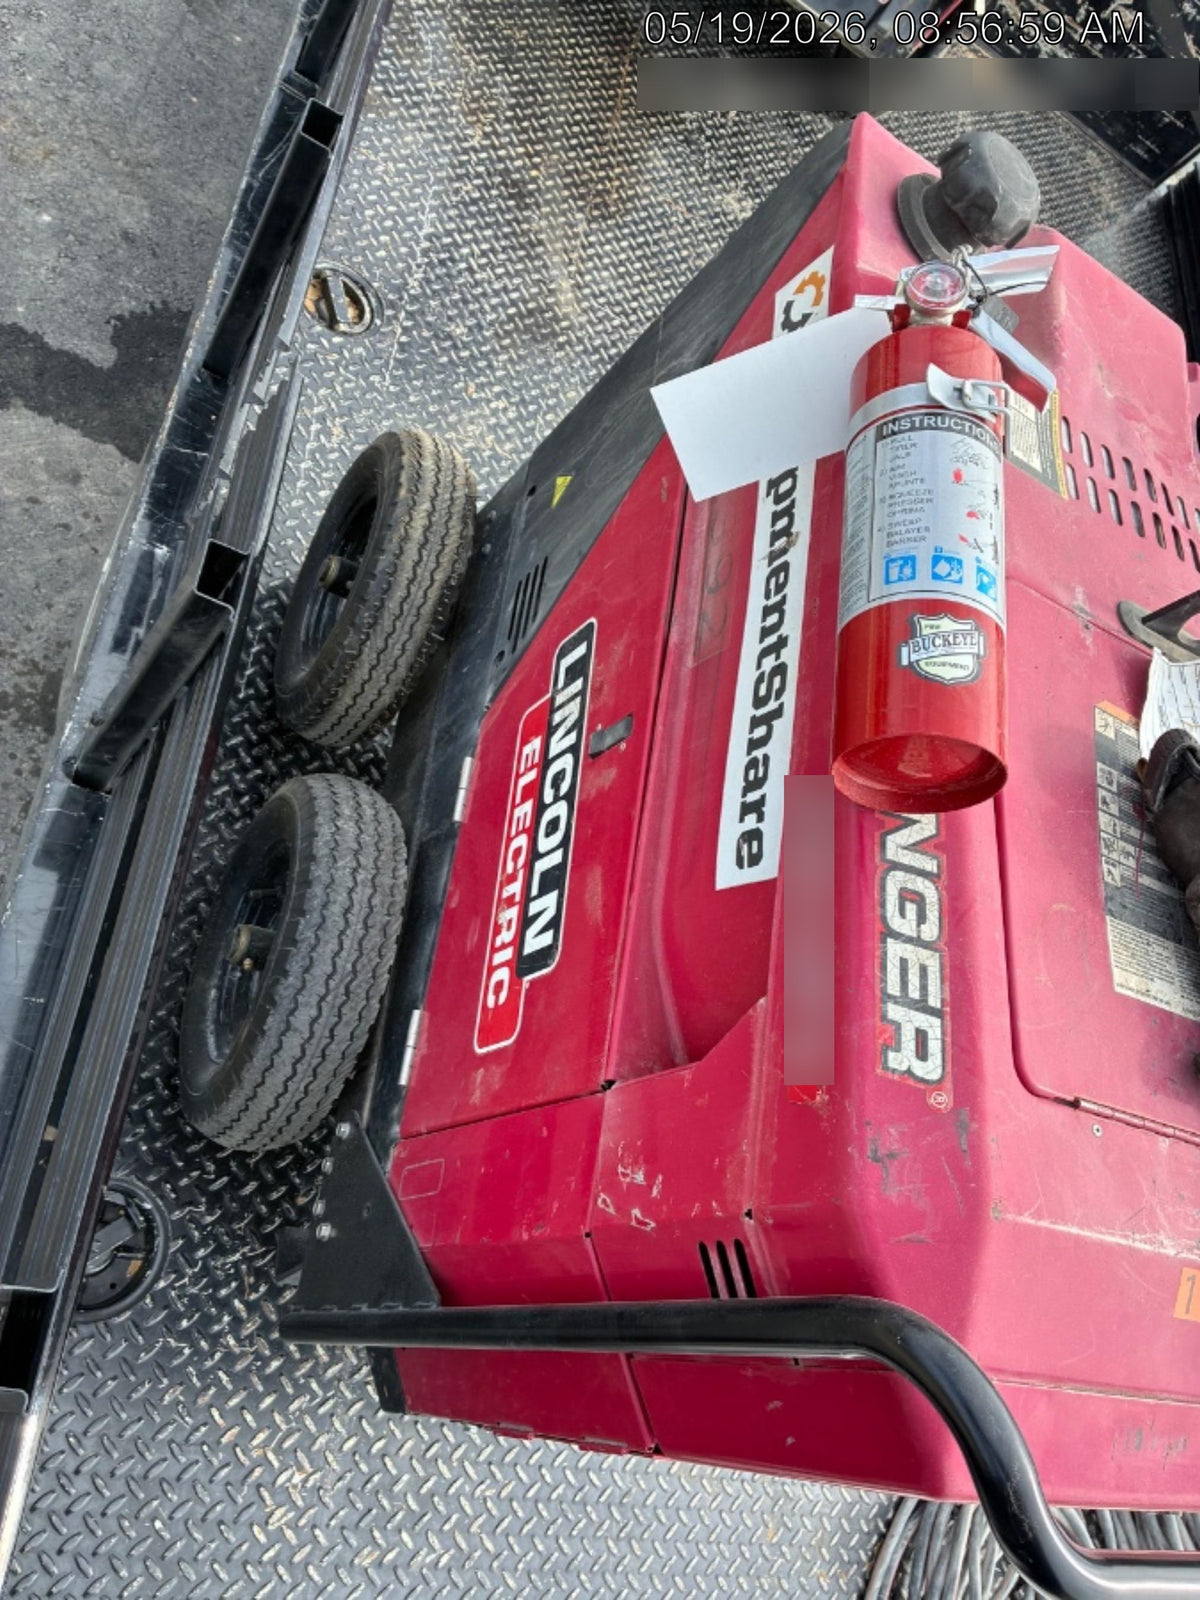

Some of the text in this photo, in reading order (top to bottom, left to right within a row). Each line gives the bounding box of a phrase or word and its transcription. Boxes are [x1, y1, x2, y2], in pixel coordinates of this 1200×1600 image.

[734, 466, 799, 871] pmentShare
[911, 632, 977, 653] BUCKEYE
[486, 735, 543, 1010] ELECTRIC
[522, 640, 588, 957] LINCOLN
[879, 809, 944, 1085] NGER
